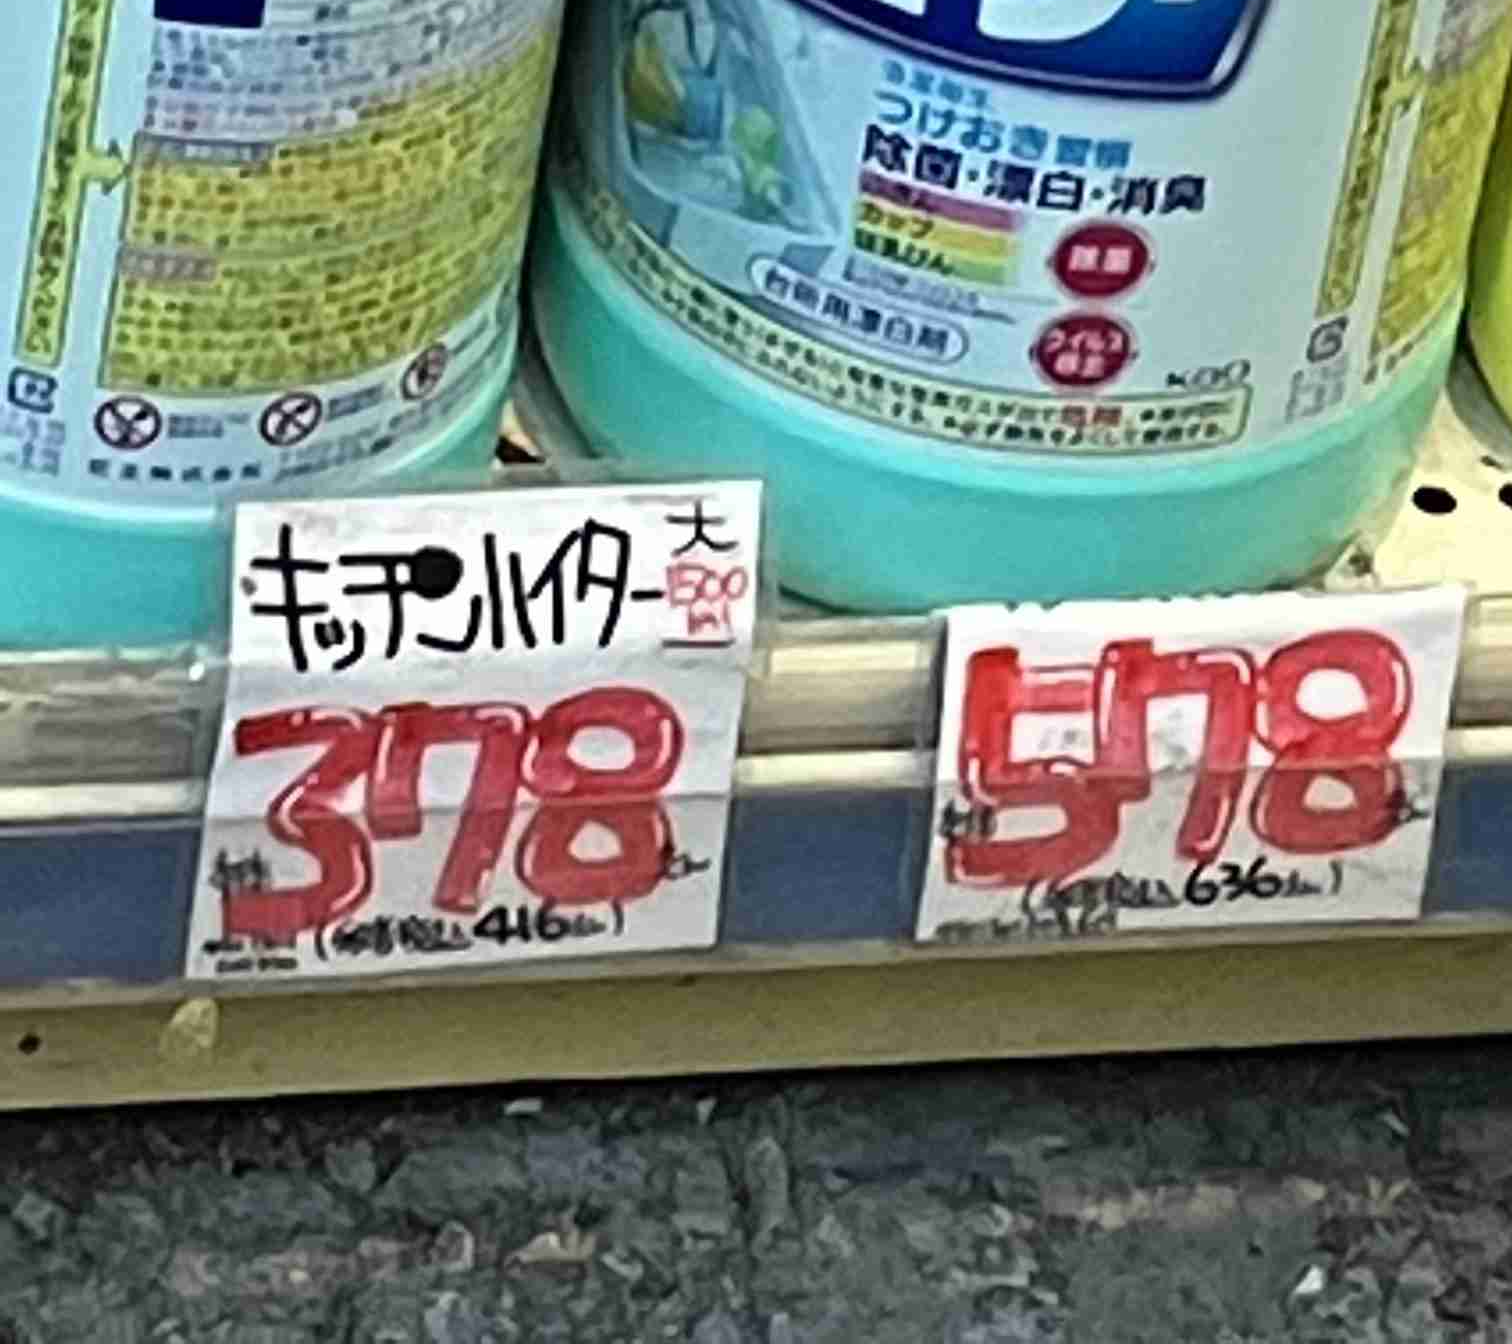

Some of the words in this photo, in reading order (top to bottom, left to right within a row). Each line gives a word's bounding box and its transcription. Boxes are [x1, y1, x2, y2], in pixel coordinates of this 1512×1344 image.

[249, 517, 665, 672] キッチンハイター
[665, 499, 740, 556] 大
[222, 684, 685, 936] 378
[945, 629, 1413, 887] 578
